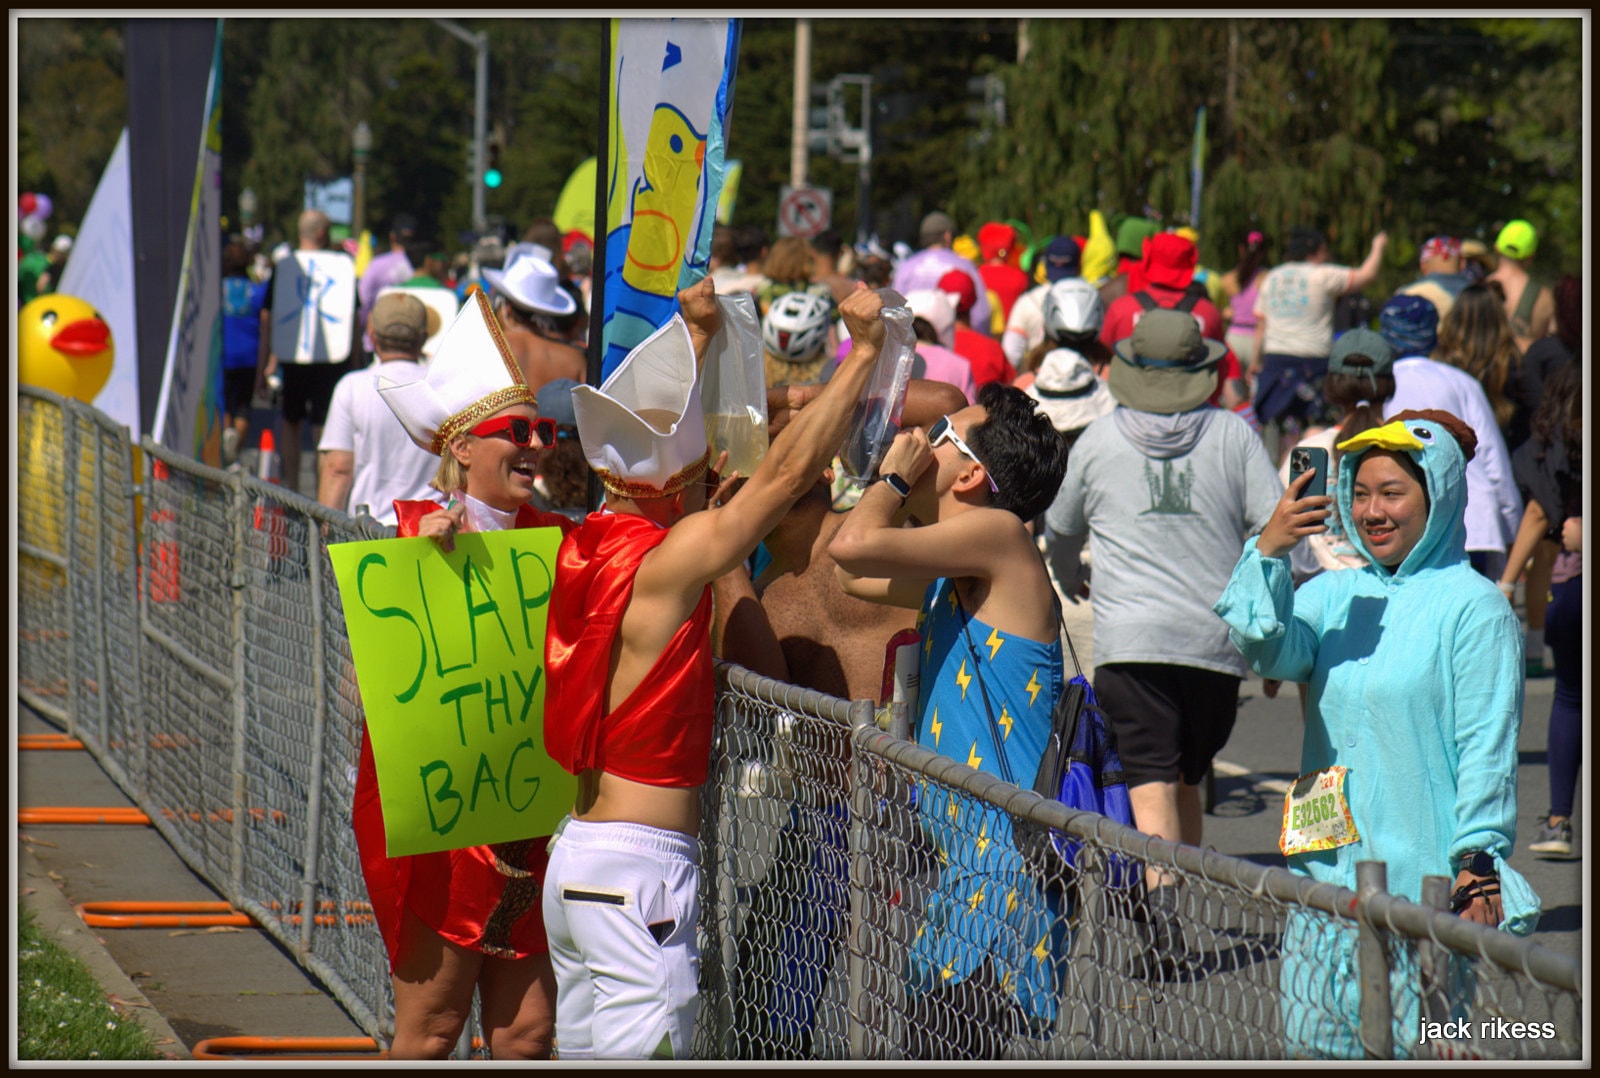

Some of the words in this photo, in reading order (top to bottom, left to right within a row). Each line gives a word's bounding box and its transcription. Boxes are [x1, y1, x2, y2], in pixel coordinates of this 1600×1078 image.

[357, 547, 552, 704] SLAP
[440, 665, 543, 747] THY
[420, 738, 540, 836] BAG
[1291, 793, 1339, 831] E32562
